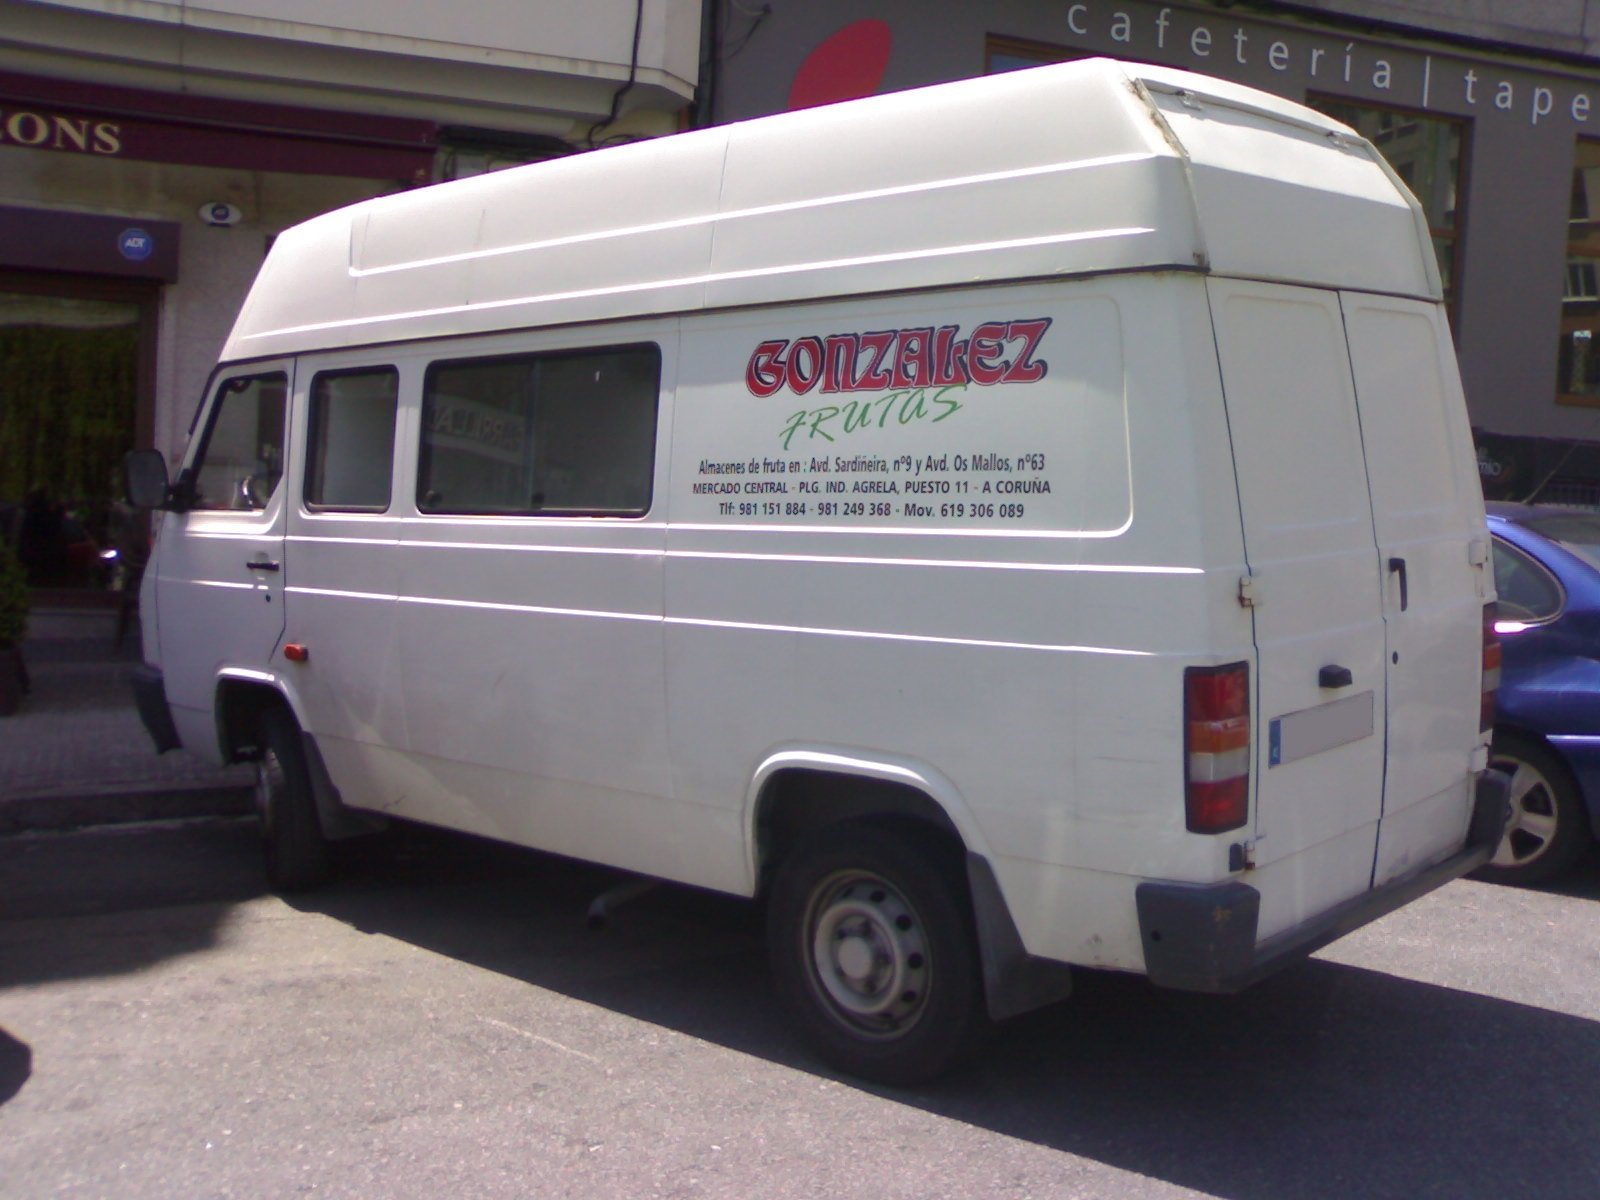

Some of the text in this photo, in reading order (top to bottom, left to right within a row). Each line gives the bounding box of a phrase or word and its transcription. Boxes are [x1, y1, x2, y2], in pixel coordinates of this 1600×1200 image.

[0, 111, 121, 154] ONS
[124, 237, 146, 248] ADT
[779, 383, 968, 451] FRUTAS
[698, 459, 746, 475] Almacenes
[748, 458, 760, 474] de
[763, 457, 786, 474] fruta
[810, 456, 831, 473] Avd.
[915, 459, 922, 476] y
[925, 454, 949, 472] Avd.
[954, 455, 968, 472] Os
[972, 453, 1012, 473] Mallos,
[693, 482, 741, 494] MERCADO
[744, 481, 788, 493] CENTRAL
[852, 481, 900, 495] AGRELA,
[905, 481, 950, 494] PUESTO
[956, 481, 968, 493] 11
[982, 481, 991, 494] A
[996, 476, 1051, 494] CORUÑA
[739, 502, 758, 515] 981
[763, 502, 781, 515] 151
[785, 503, 806, 515] 884
[818, 502, 838, 515] 981
[843, 503, 864, 515] 249
[869, 503, 891, 516] 368
[904, 503, 935, 517] Mov.
[940, 503, 964, 517] 619
[969, 503, 994, 517] 306
[1000, 503, 1024, 517] 089
